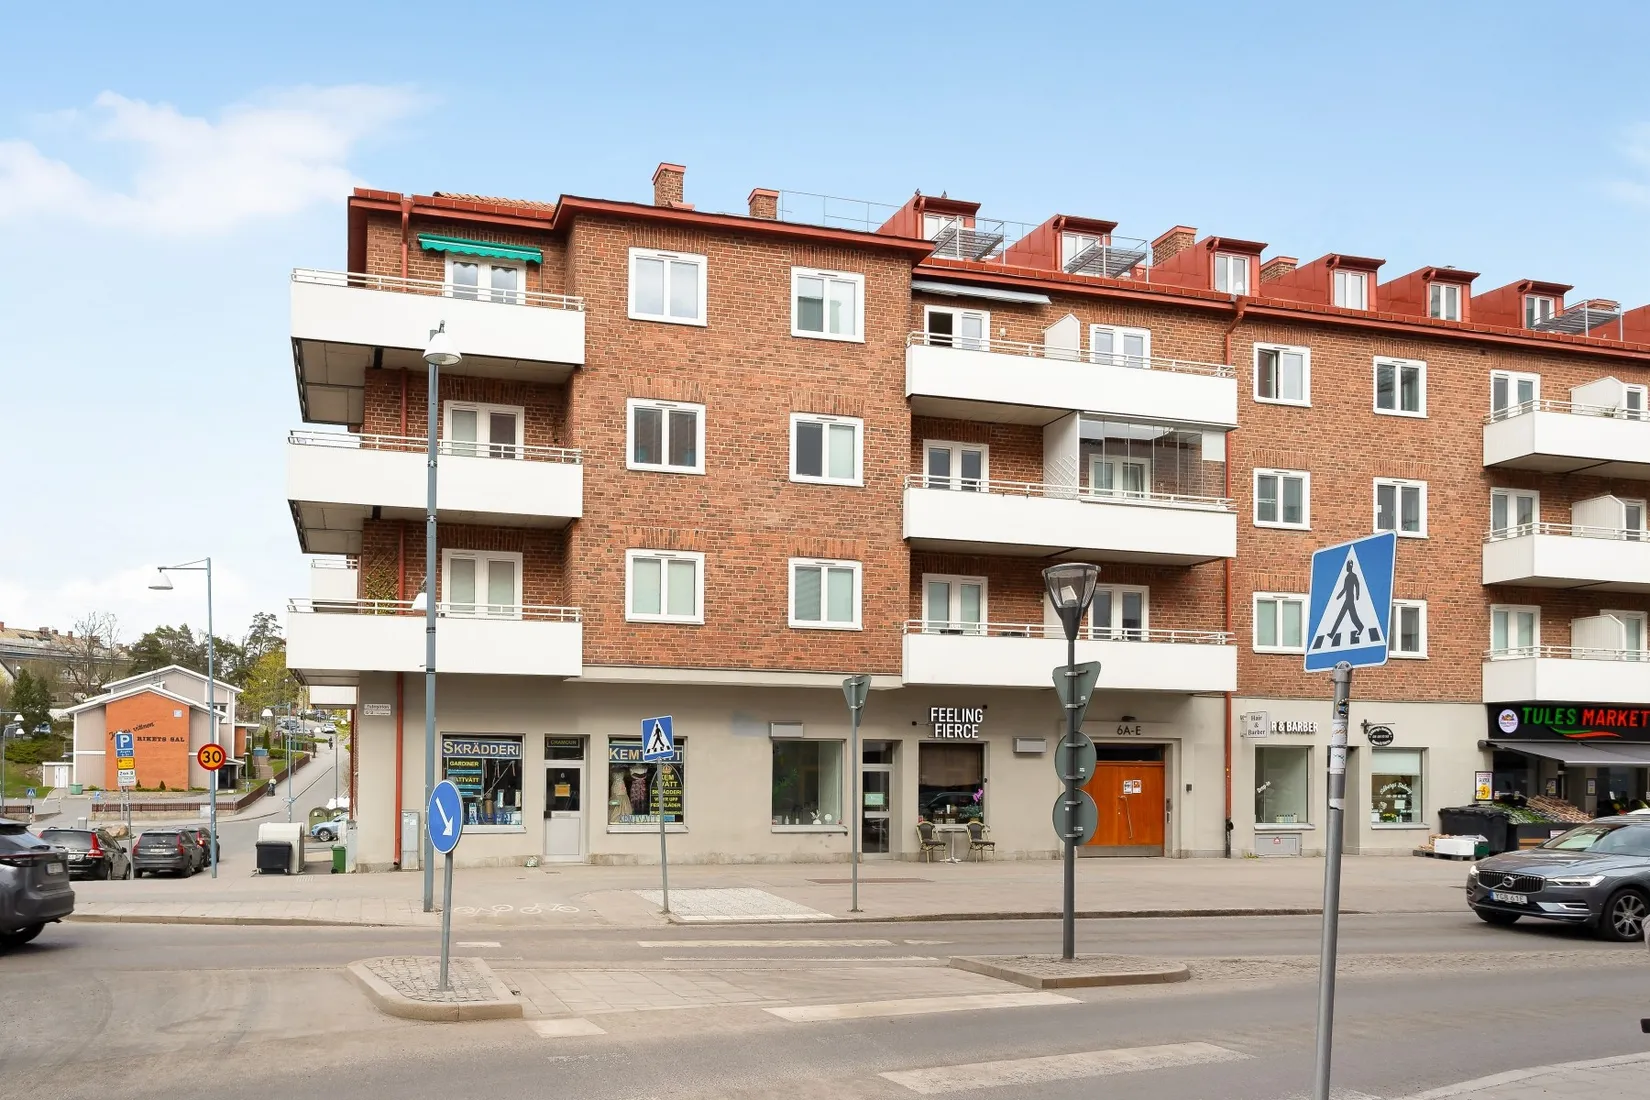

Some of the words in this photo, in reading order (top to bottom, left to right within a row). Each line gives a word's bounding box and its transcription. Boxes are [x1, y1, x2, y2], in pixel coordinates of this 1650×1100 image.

[930, 707, 983, 722] FEELING
[1523, 707, 1577, 724] TULES
[1582, 709, 1650, 726] MARKET
[934, 723, 979, 738] FIERCE
[1117, 725, 1142, 736] 6A-E
[1286, 722, 1319, 733] BARBER
[443, 741, 519, 755] SKRÄDDERI
[609, 747, 681, 760] KEMT
[202, 750, 222, 764] 30
